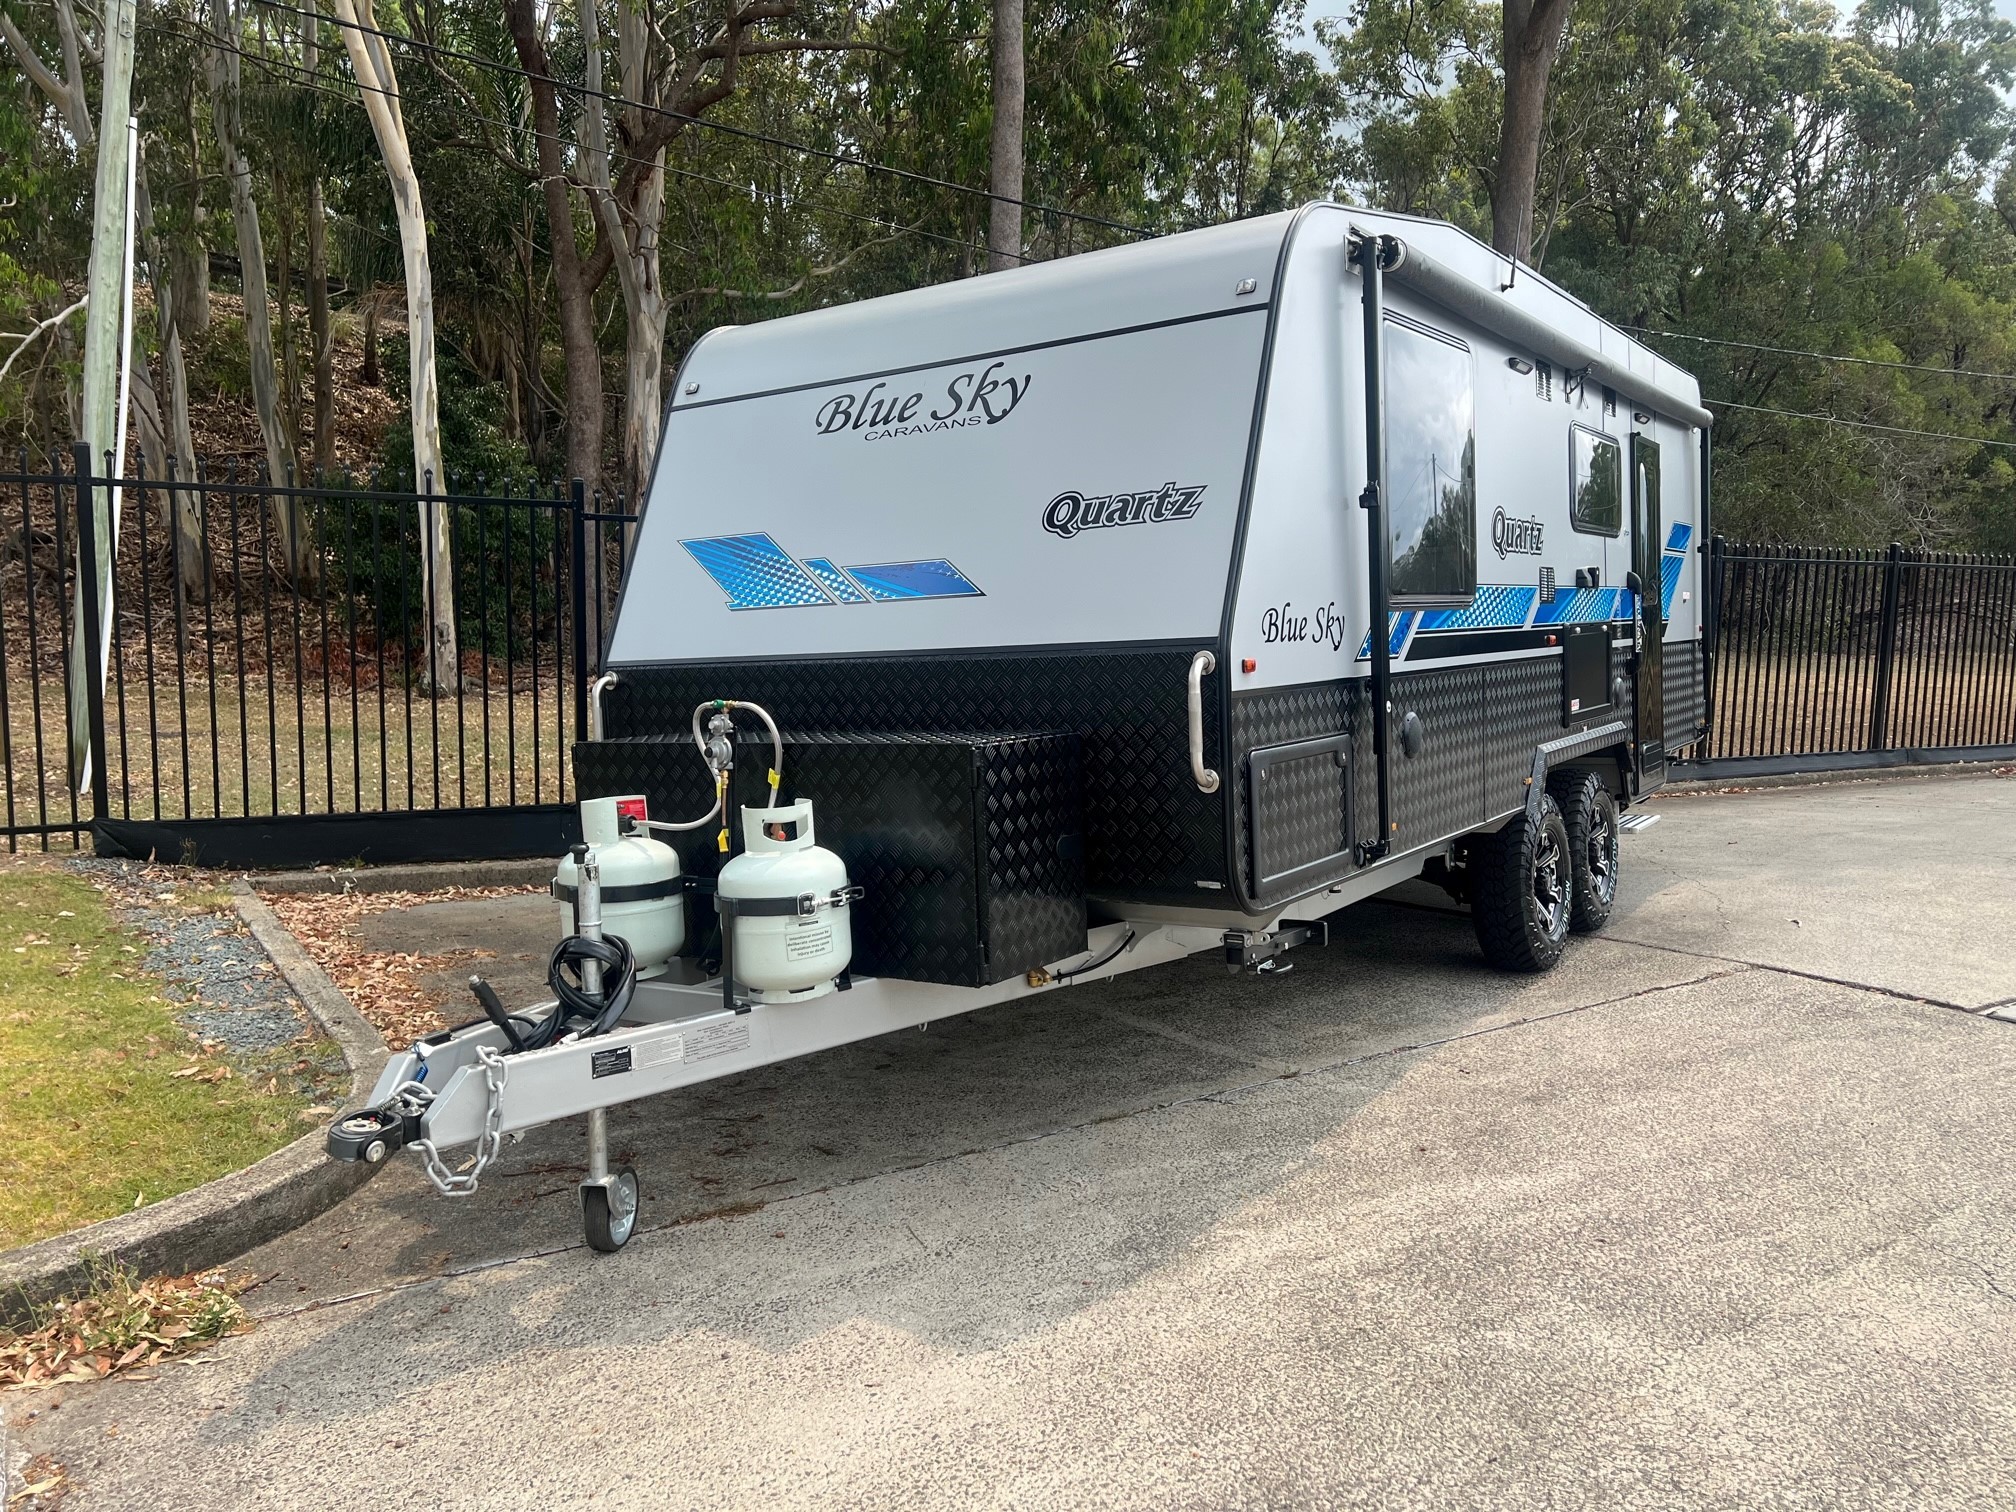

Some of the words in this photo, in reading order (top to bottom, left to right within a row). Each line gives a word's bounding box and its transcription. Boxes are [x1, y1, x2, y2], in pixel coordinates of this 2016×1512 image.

[815, 382, 923, 435] Blue
[930, 361, 1032, 424] Sky
[864, 415, 981, 442] CARAVANS
[1041, 481, 1208, 539] Quartz
[1491, 505, 1544, 560] Quartz
[1261, 602, 1307, 643] Blue
[1312, 601, 1345, 651] Sky
